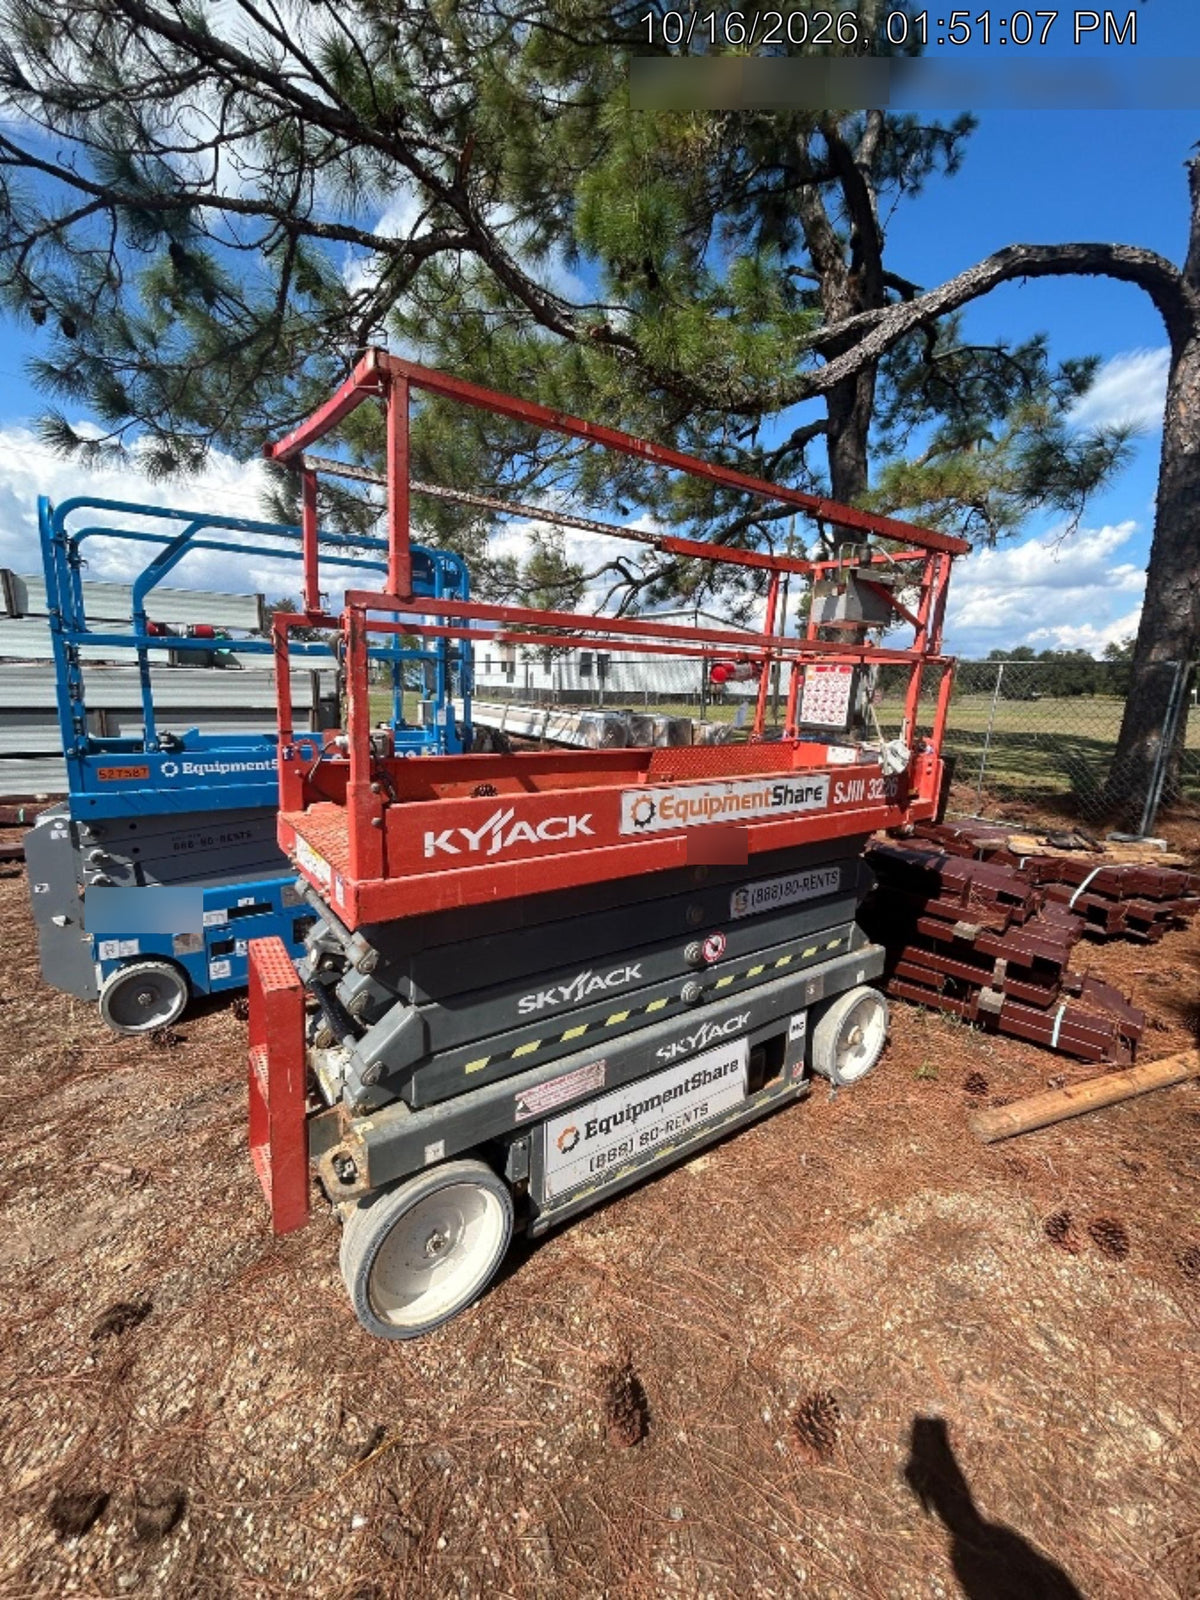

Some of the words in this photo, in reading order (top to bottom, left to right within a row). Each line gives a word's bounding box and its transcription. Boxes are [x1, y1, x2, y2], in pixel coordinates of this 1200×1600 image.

[182, 758, 279, 776] EquipmentS
[867, 777, 898, 800] 3226
[659, 784, 823, 822] EquipmentShare
[518, 963, 642, 1014] SKYJACK
[656, 1011, 751, 1061] SKYJACK
[584, 1059, 739, 1140] EquipmentShare
[639, 1102, 709, 1146] 80-RENTS
